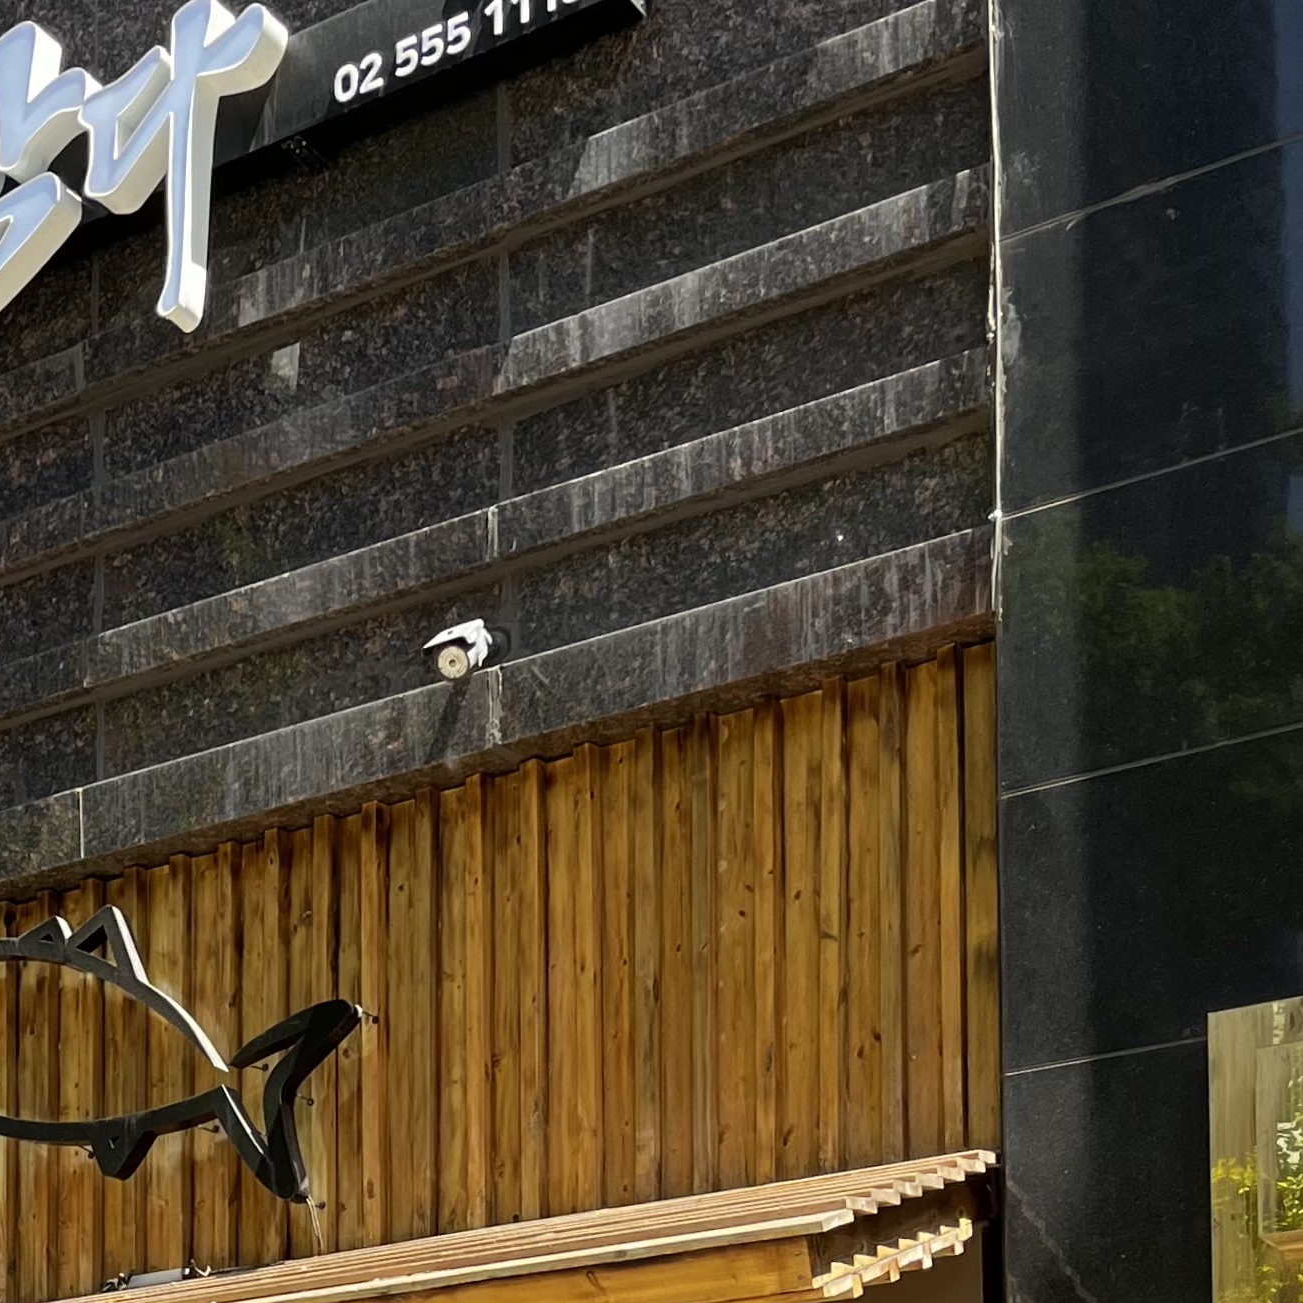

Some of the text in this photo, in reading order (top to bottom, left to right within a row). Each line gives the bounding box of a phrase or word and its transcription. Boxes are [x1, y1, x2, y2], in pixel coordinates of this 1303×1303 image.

[334, 0, 579, 102] 02 555 11
